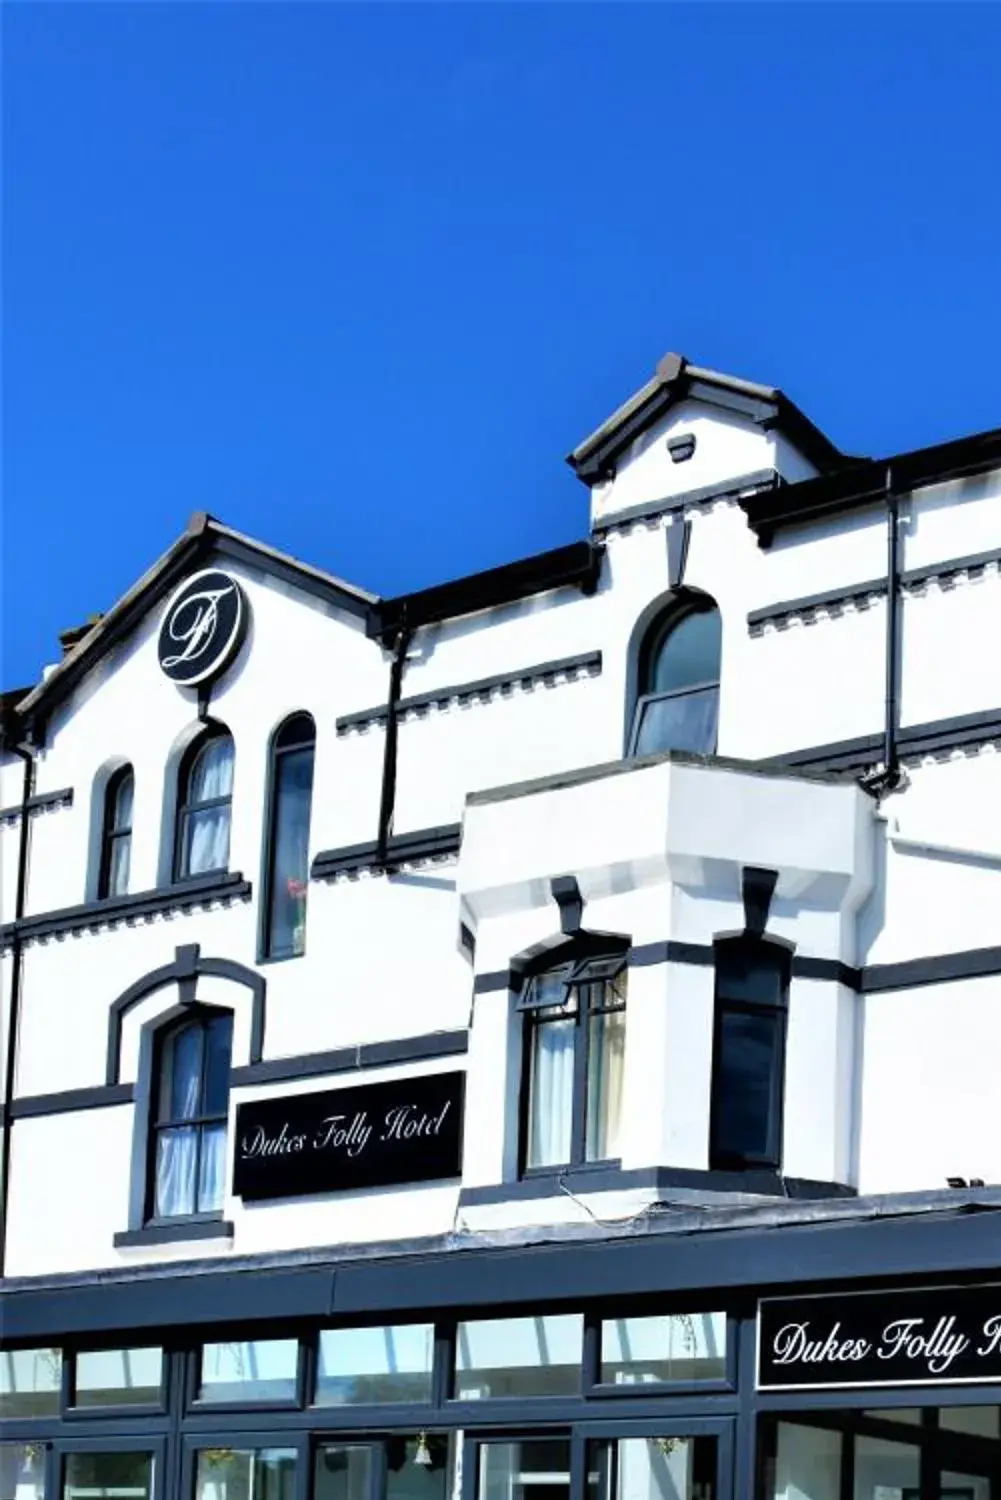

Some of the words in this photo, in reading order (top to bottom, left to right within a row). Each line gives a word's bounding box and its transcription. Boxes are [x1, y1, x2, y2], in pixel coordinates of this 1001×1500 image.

[241, 1122, 307, 1159] Dukes
[313, 1112, 373, 1157] Folly
[380, 1100, 451, 1141] Hotel
[772, 1321, 873, 1365] Dukes
[876, 1315, 970, 1373] Folly
